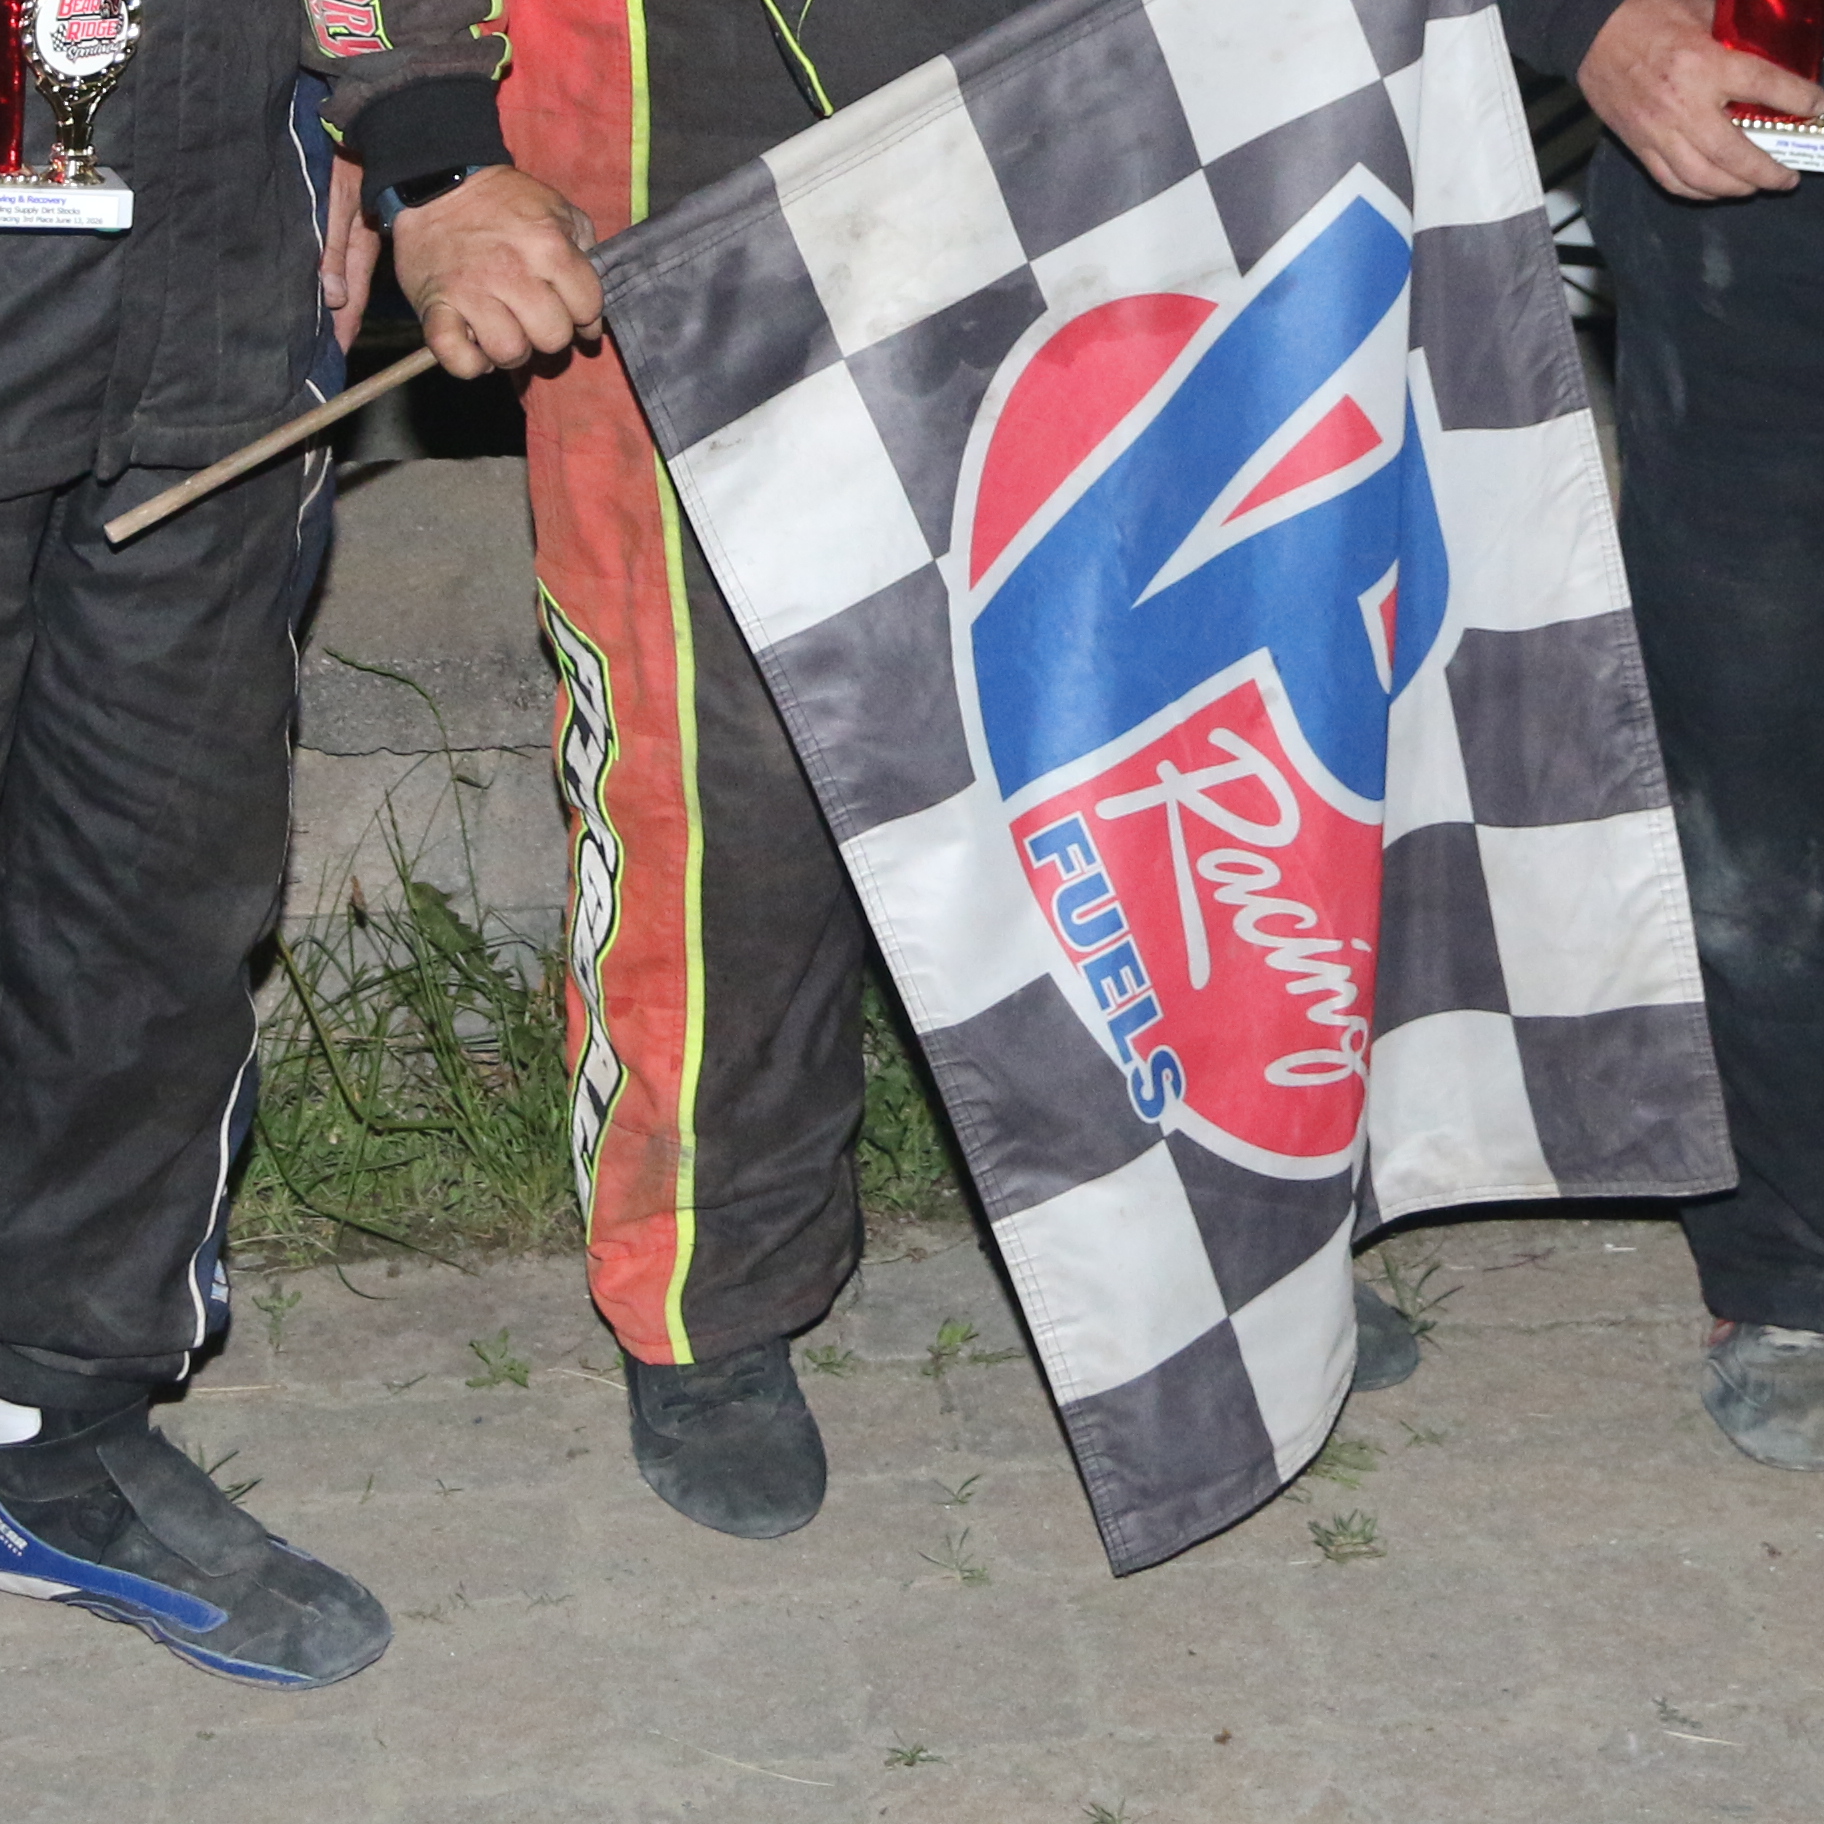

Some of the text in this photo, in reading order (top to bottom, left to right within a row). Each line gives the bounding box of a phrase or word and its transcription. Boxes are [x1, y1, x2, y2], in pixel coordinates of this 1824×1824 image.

[66, 20, 119, 41] RIDGE
[27, 196, 66, 205] Recovery
[15, 206, 38, 215] Supply
[57, 207, 80, 215] Stocks
[0, 215, 19, 223] racing
[55, 216, 71, 224] June
[1095, 726, 1374, 1087] Racing
[1023, 814, 1187, 1124] FUELS
